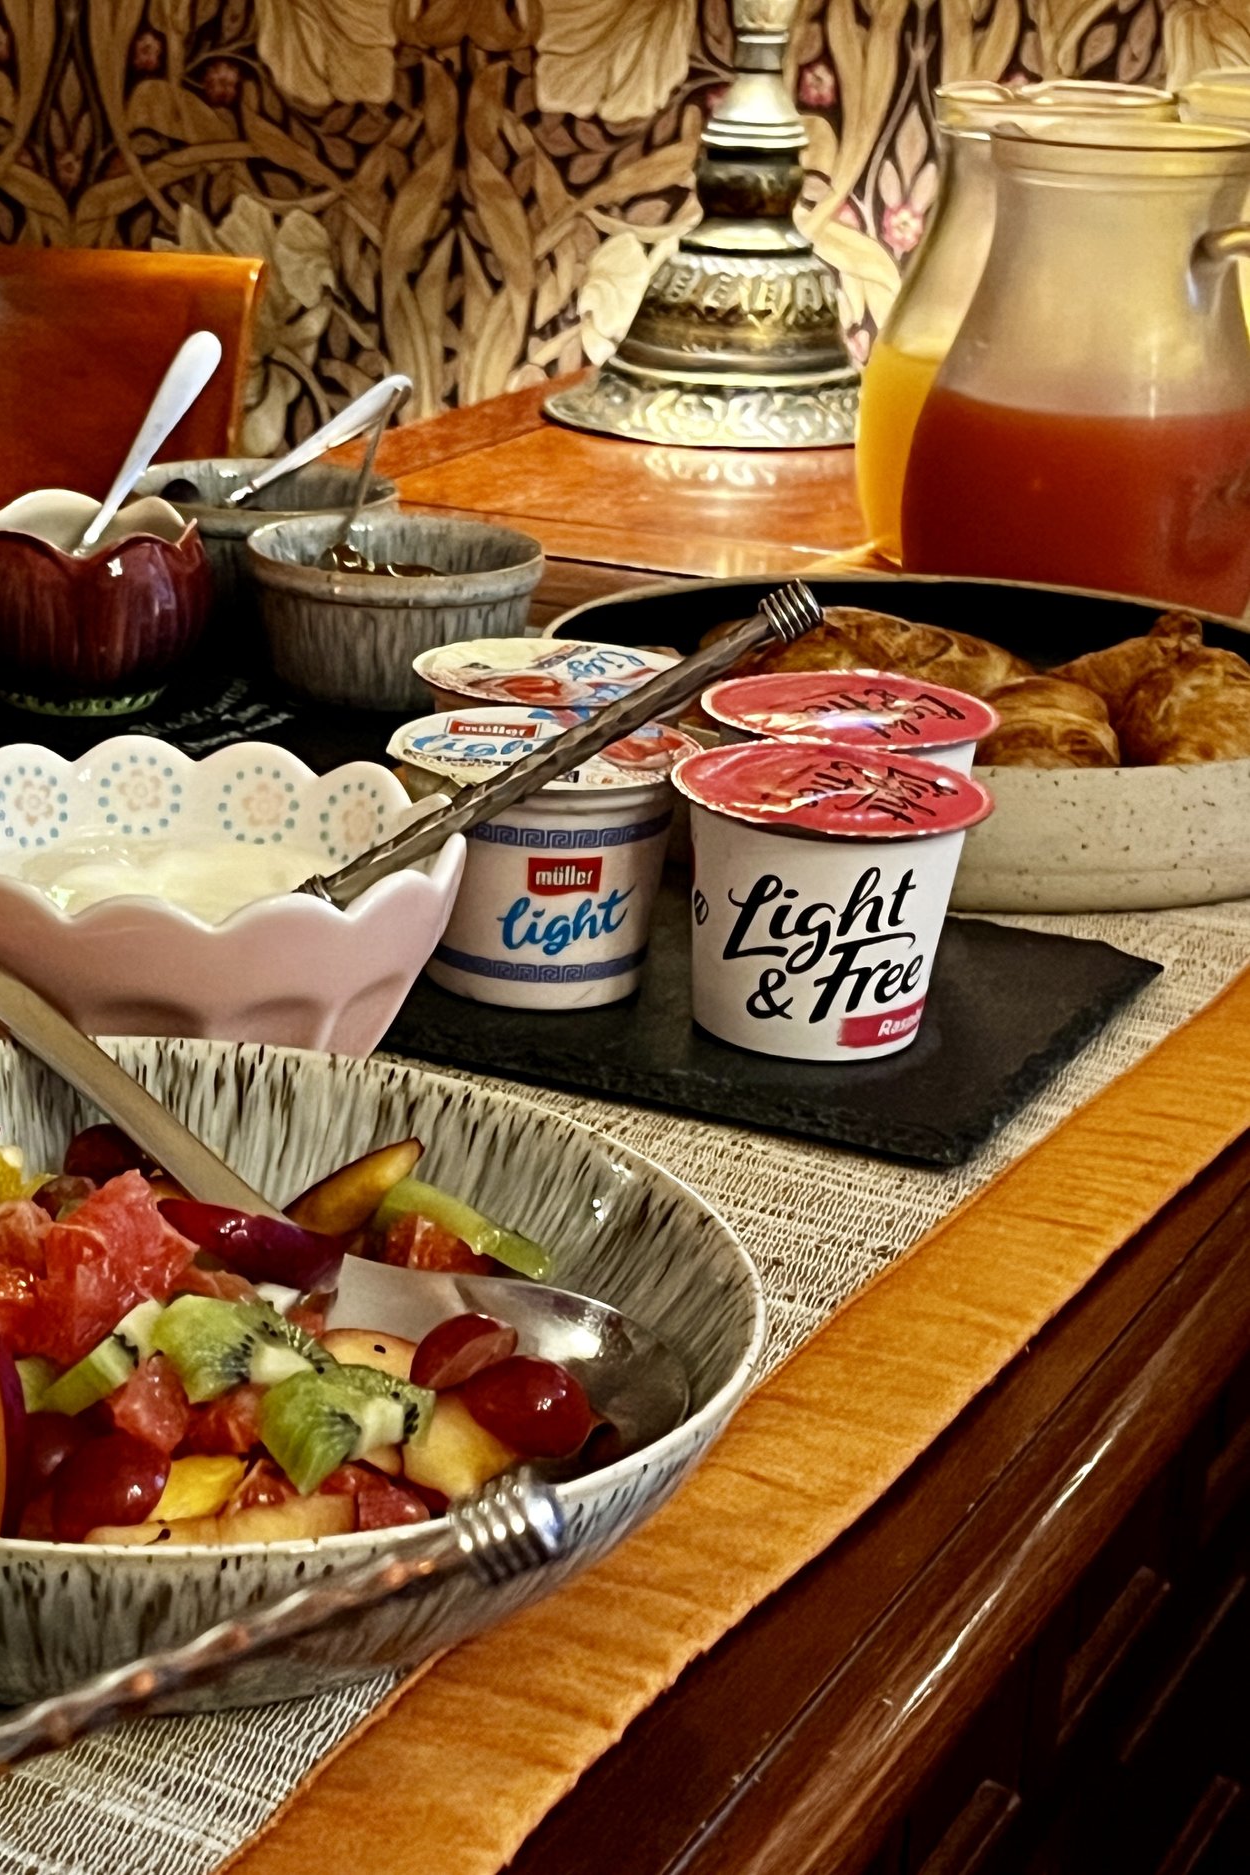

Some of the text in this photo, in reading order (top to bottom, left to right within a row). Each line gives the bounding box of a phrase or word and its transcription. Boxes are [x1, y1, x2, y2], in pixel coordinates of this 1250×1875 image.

[535, 864, 595, 887] müller
[496, 884, 637, 956] light
[722, 866, 917, 975] Light
[745, 932, 924, 1024] & Free
